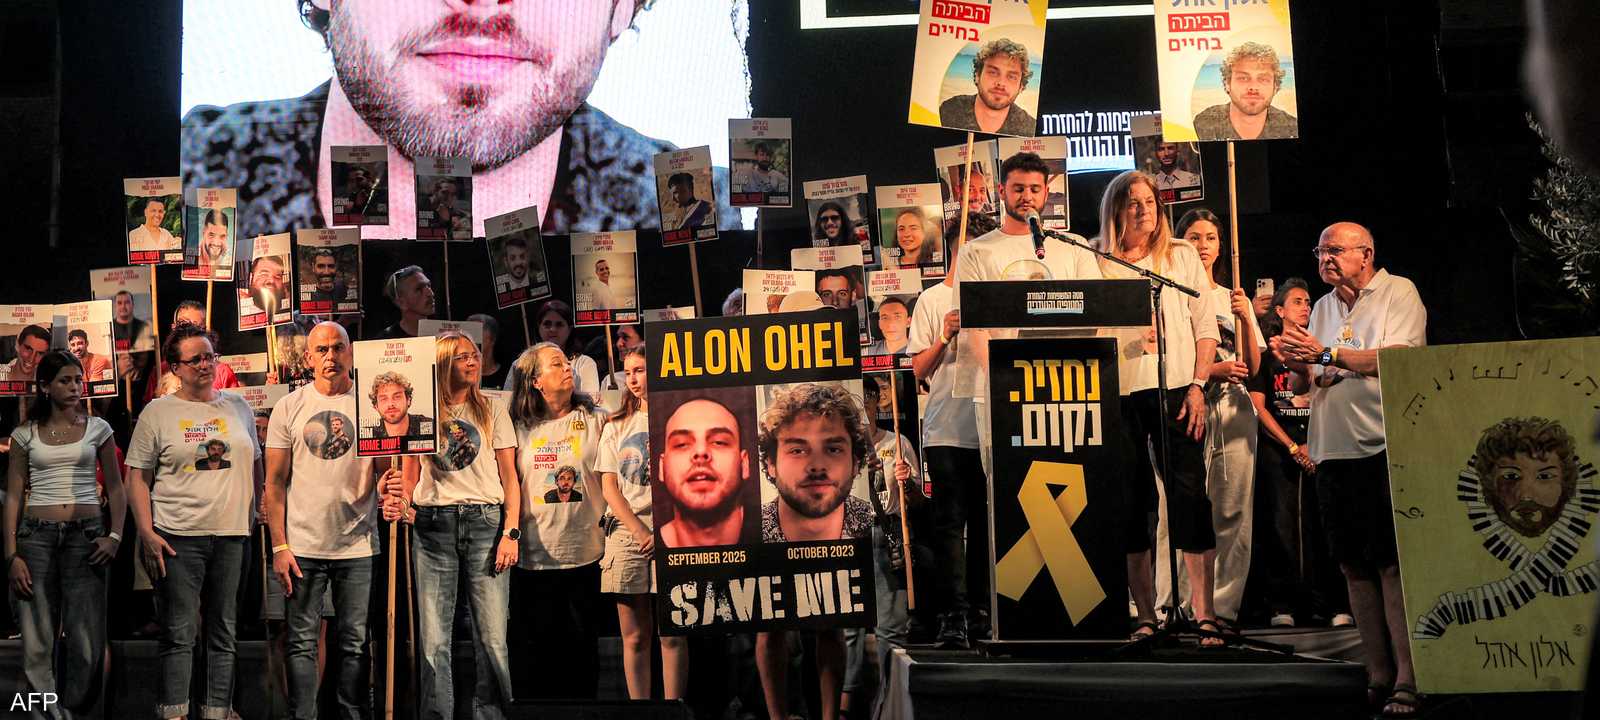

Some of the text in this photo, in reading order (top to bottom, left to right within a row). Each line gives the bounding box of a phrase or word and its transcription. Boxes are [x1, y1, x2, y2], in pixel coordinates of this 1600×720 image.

[935, 2, 986, 21] הביתה
[1171, 15, 1226, 30] הביתה
[929, 23, 980, 42] בחיים
[1168, 37, 1223, 52] בחיים
[1042, 110, 1094, 135] להחזרת
[660, 321, 854, 378] ALON OHEL
[360, 427, 374, 439] HIM
[360, 440, 380, 451] HOME
[382, 437, 400, 450] NOW!
[668, 550, 746, 566] SEPTEMBER 2025
[787, 545, 855, 560] OCTOBER 2023
[670, 569, 864, 629] SAVE ME
[1475, 634, 1576, 680] אלון אהל
